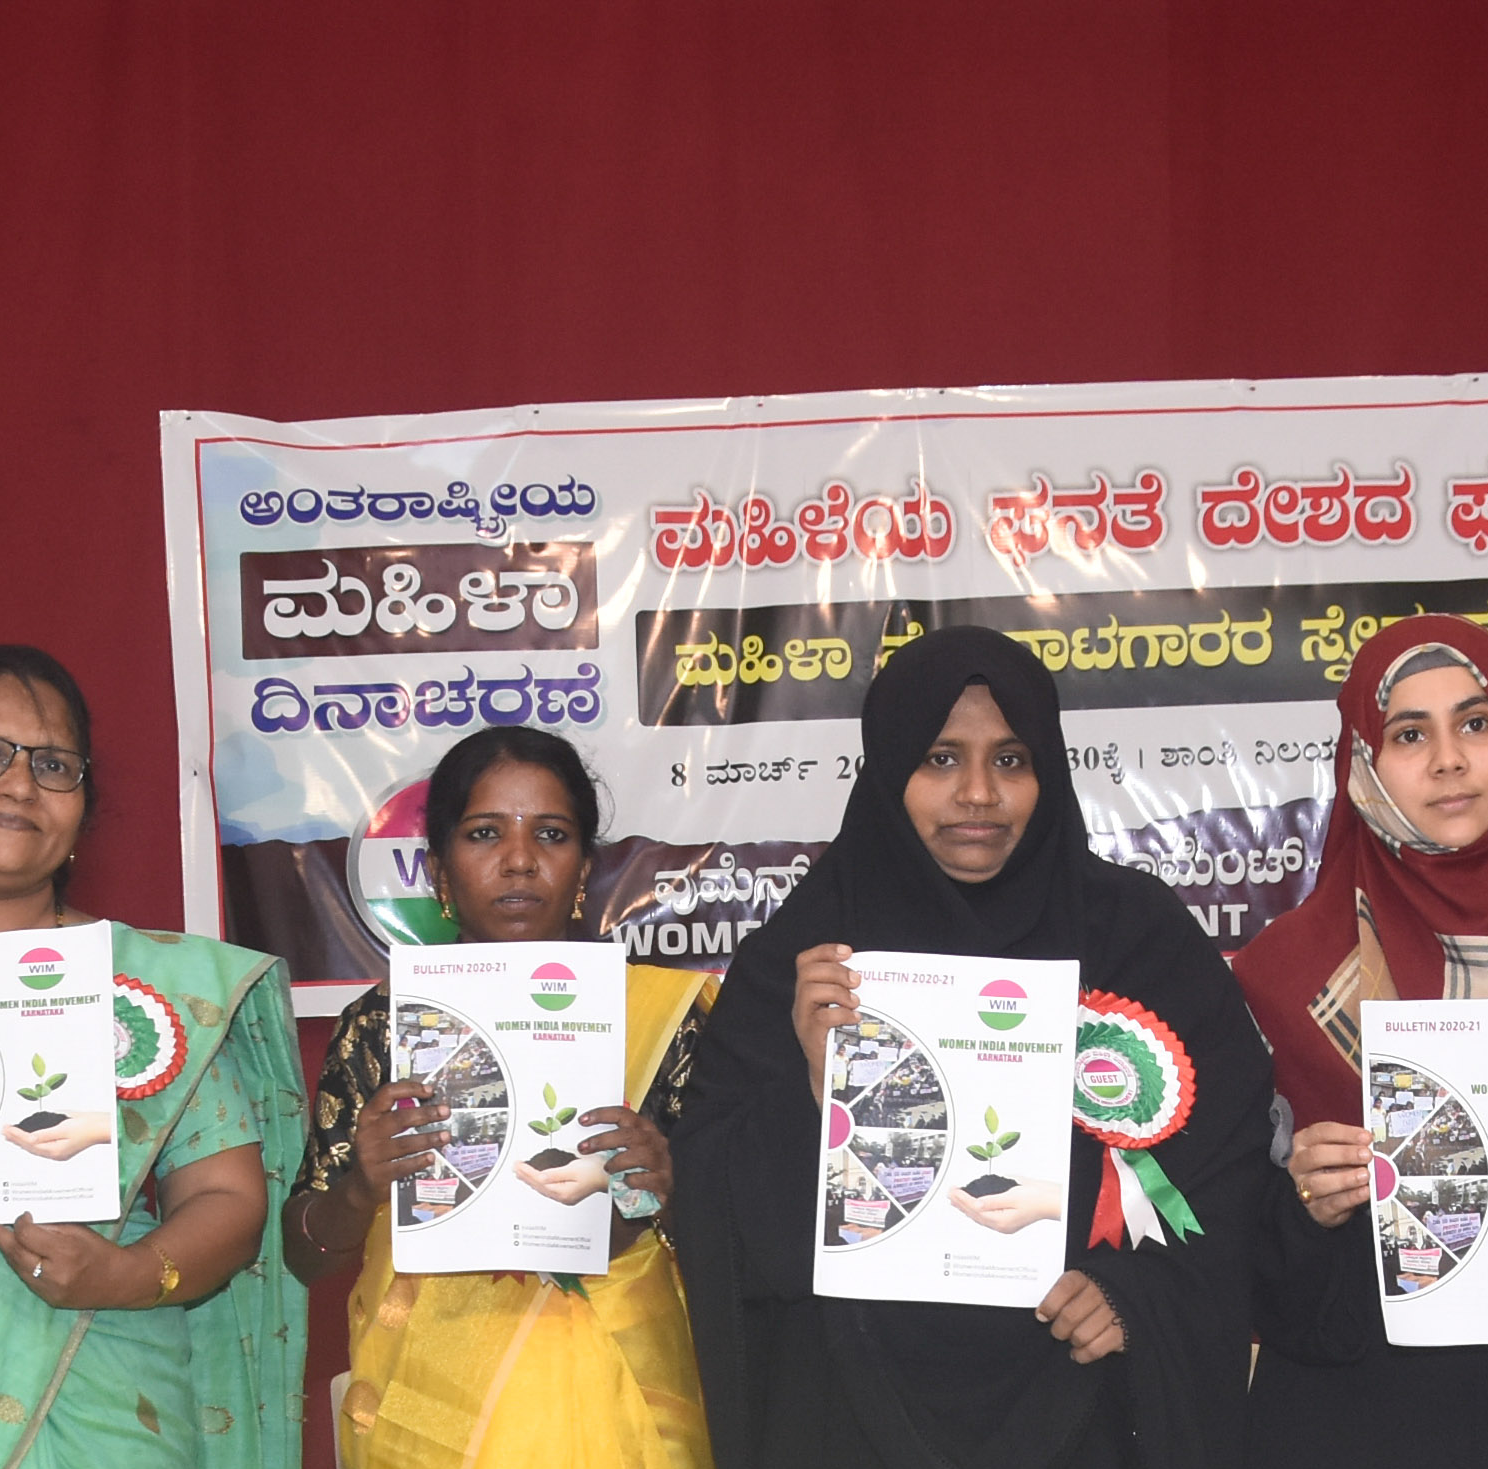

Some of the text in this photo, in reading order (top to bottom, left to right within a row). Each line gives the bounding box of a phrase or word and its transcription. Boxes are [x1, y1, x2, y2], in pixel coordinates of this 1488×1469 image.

[654, 480, 953, 568] ಮಹಿಳೆಯ
[990, 471, 1164, 567] ಘನತೆ
[1201, 464, 1414, 547] ದೇಶದ
[263, 558, 579, 639] ಮಹಿಳಾ
[675, 630, 852, 686] ಮಹಿಳಾ
[251, 662, 601, 733] ದಿನಾಚರಣೆ
[671, 762, 687, 787] 8
[29, 964, 54, 973] WIM
[414, 963, 506, 974] BULLETIN 2020-21
[912, 973, 954, 984] 2020-21
[541, 982, 567, 991] WIM
[22, 999, 47, 1008] INDIA
[50, 994, 100, 1006] MOVEMENT
[990, 1000, 1016, 1010] WIM
[495, 1021, 611, 1032] WOMEN INDIA MOVEMENT
[1386, 1021, 1480, 1032] BULLETIN 2020-21
[533, 1033, 575, 1041] KARNATAKA
[939, 1039, 1062, 1053] WOMEN INDIA MOVEMENT
[977, 1053, 1022, 1062] KARNATAKA
[1090, 1075, 1118, 1083] GUEST
